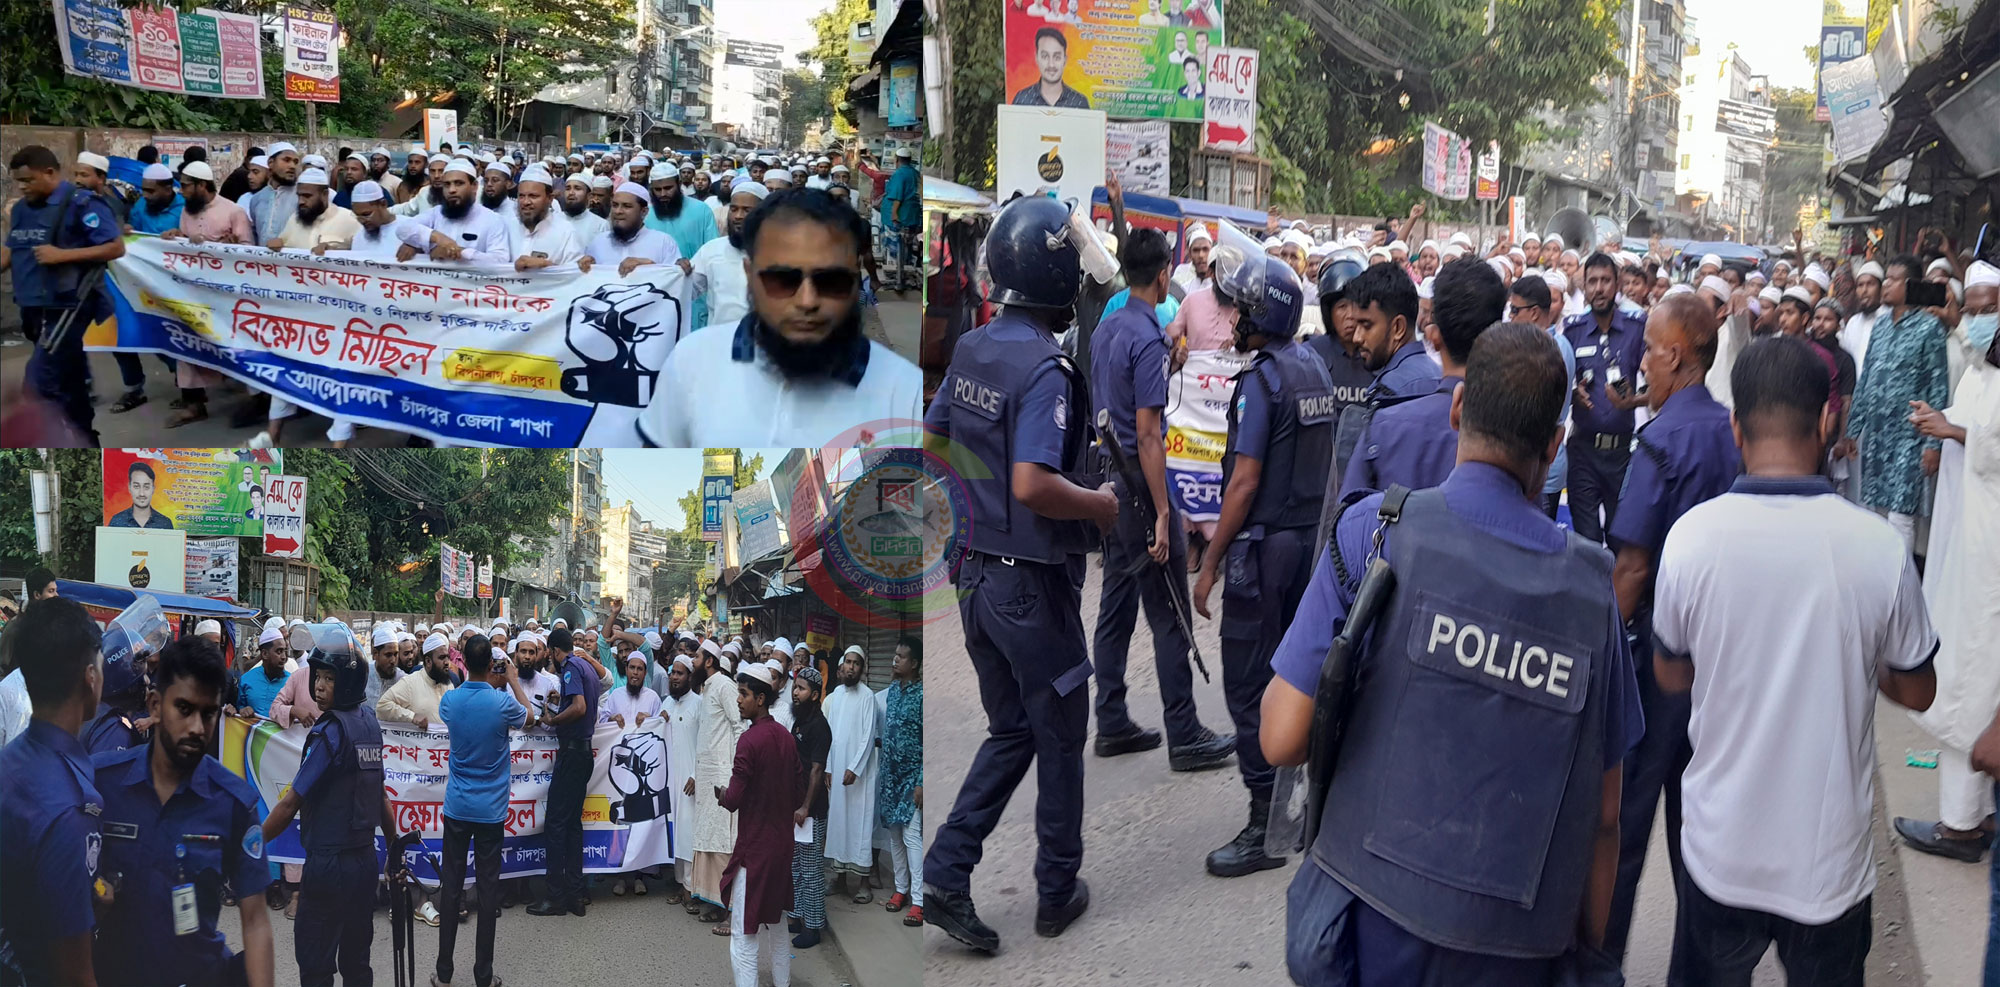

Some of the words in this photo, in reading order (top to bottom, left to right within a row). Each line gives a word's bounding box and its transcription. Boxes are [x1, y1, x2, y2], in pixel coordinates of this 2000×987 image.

[288, 8, 309, 19] HSC
[311, 12, 334, 24] 2022
[162, 251, 223, 272] মুফতি
[234, 259, 279, 278] শেখ
[287, 265, 372, 292] মুহাম্মদ
[377, 276, 443, 303] নুরুন
[449, 284, 555, 313] নাবীকে
[240, 282, 271, 300] মিথ্যা
[274, 289, 314, 306] মামলা
[317, 295, 367, 314] প্রত্যাহার
[372, 306, 383, 316] ও
[387, 304, 434, 322] নিঃশর্ত
[1268, 286, 1292, 305] POLICE
[230, 298, 335, 355] বিক্ষোভ
[338, 317, 437, 377] মিছিল
[510, 370, 546, 388] চাঁদপুর
[285, 369, 393, 409] আন্দোলন
[400, 395, 451, 428] চাঁদপুর
[456, 413, 504, 433] জেলা
[508, 417, 554, 439] শাখা
[954, 377, 1001, 414] POLICE
[1299, 395, 1334, 417] POLICE
[107, 646, 129, 664] POLICE
[1427, 613, 1574, 698] POLICE
[358, 748, 381, 761] POLICE
[382, 743, 422, 763] শেখ
[427, 748, 450, 768] মুহ
[510, 749, 535, 764] রুন
[384, 767, 411, 783] মিথ্যা
[414, 772, 448, 785] মামলা
[510, 770, 531, 784] ঃশর্ত
[533, 770, 552, 785] মুক্তি
